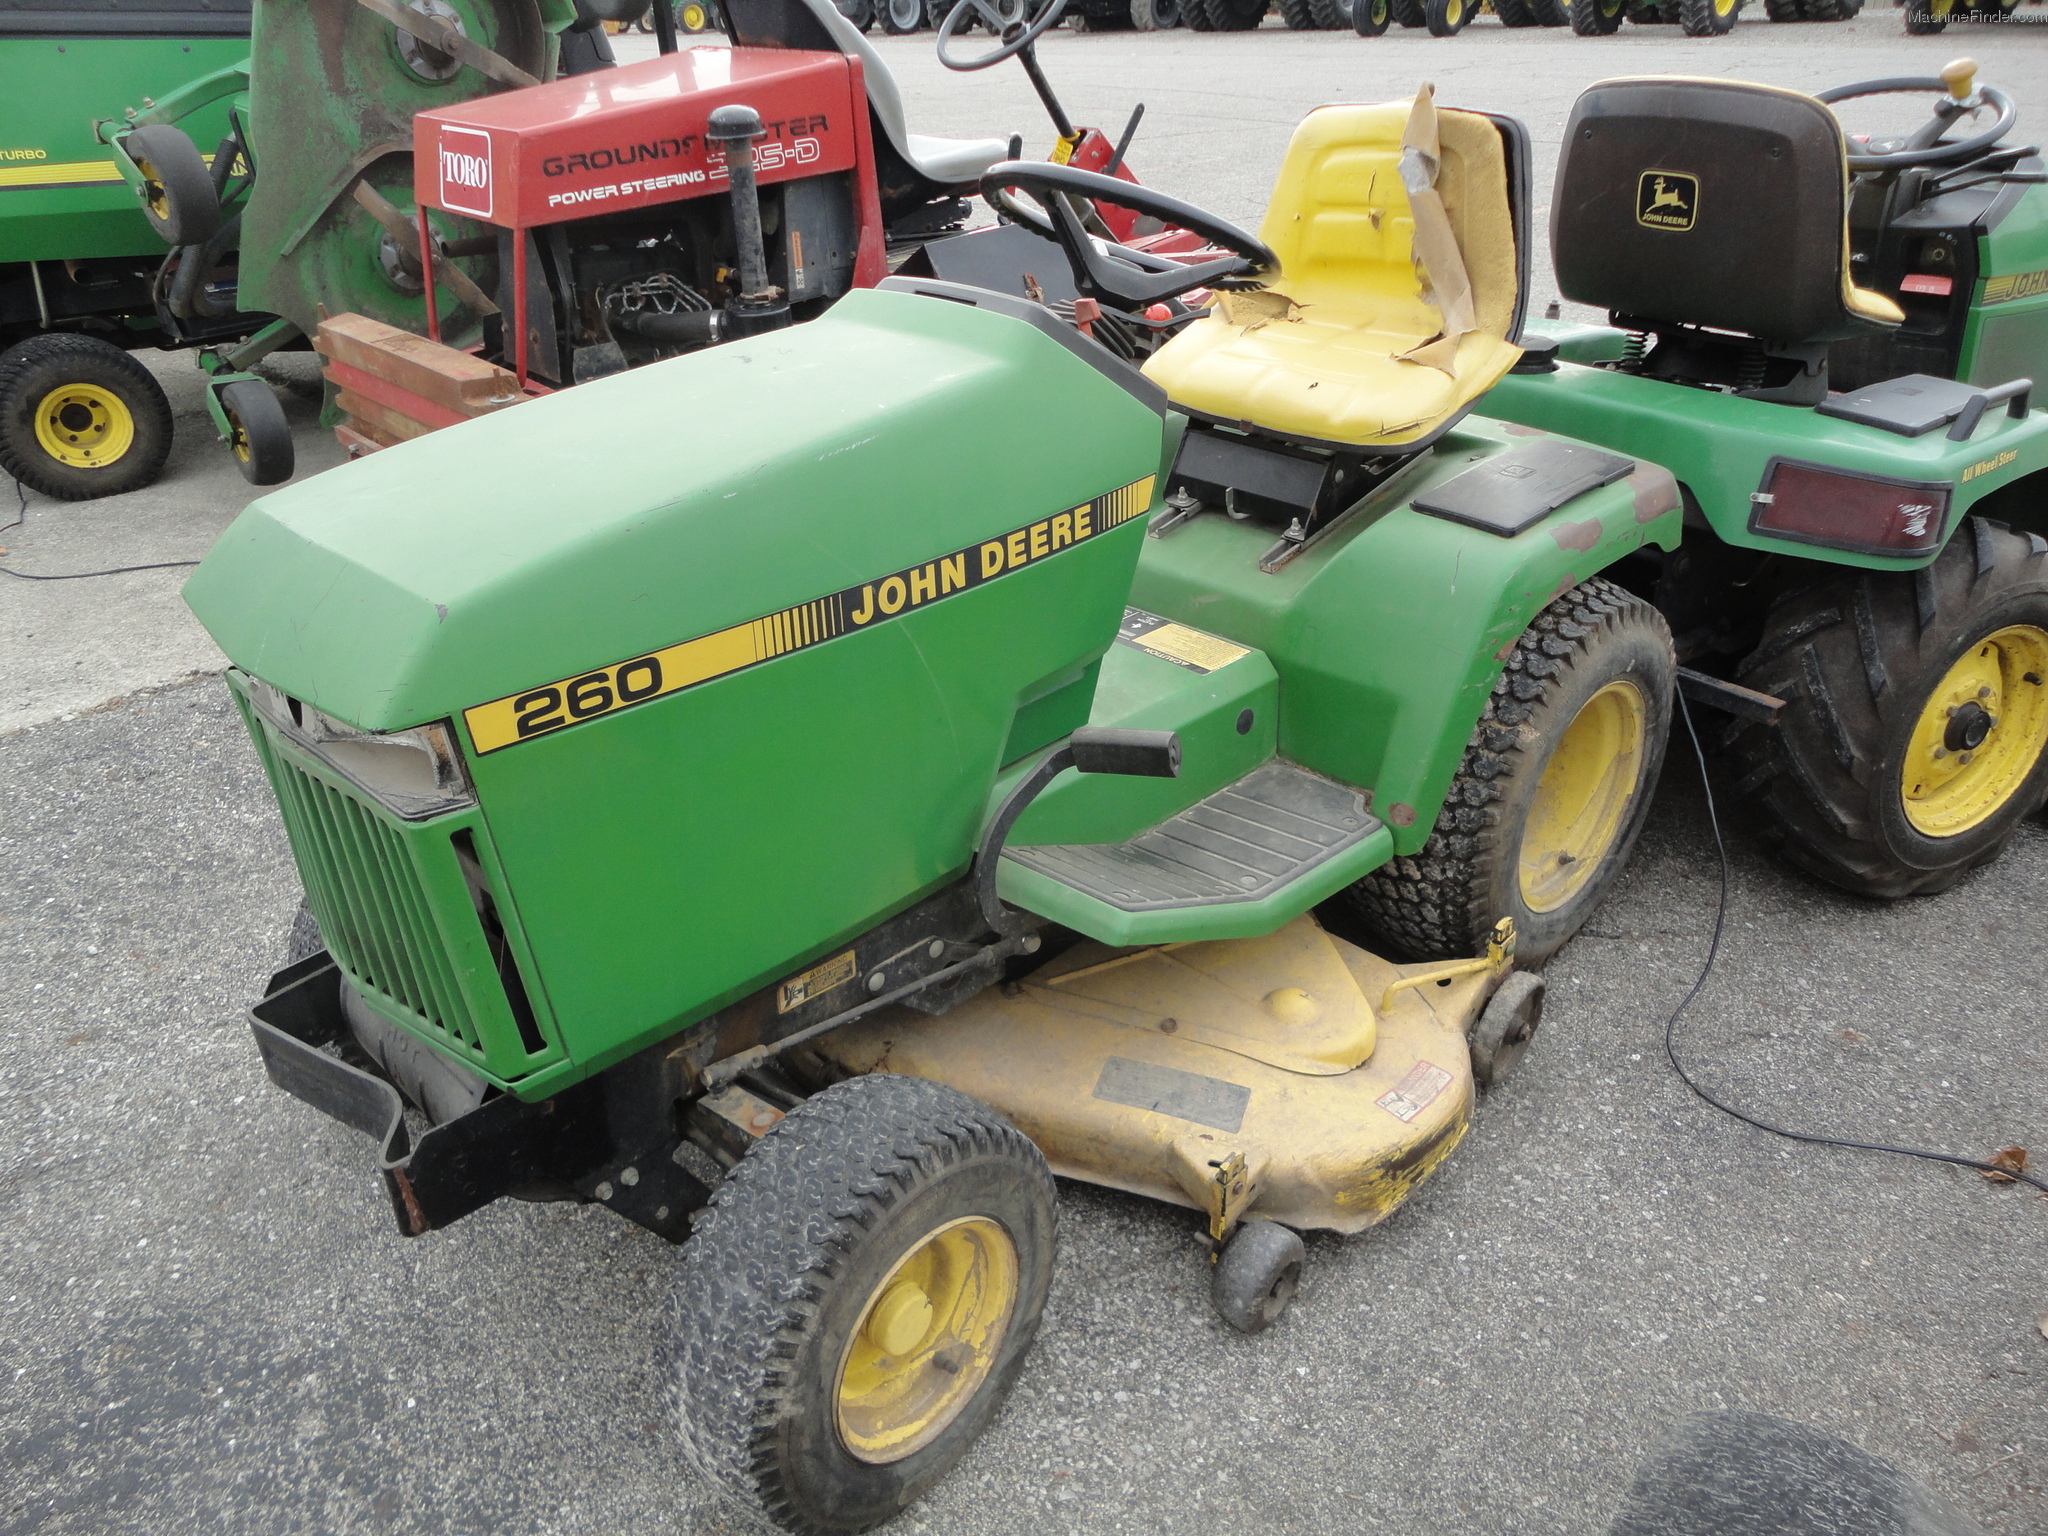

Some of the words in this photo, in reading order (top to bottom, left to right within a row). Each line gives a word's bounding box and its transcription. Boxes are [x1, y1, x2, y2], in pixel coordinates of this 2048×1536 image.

[443, 151, 487, 188] TORO
[549, 185, 619, 208] POWER
[621, 170, 706, 195] STEERING
[1642, 213, 1662, 223] JOHN
[1663, 215, 1689, 226] DEERE
[1961, 466, 1975, 484] All
[1974, 454, 1999, 478] Wheel
[1998, 449, 2018, 467] Steer
[513, 656, 663, 739] 260
[852, 552, 966, 626] JOHN
[980, 503, 1092, 579] DEERE
[1144, 648, 1182, 665] CAUTION
